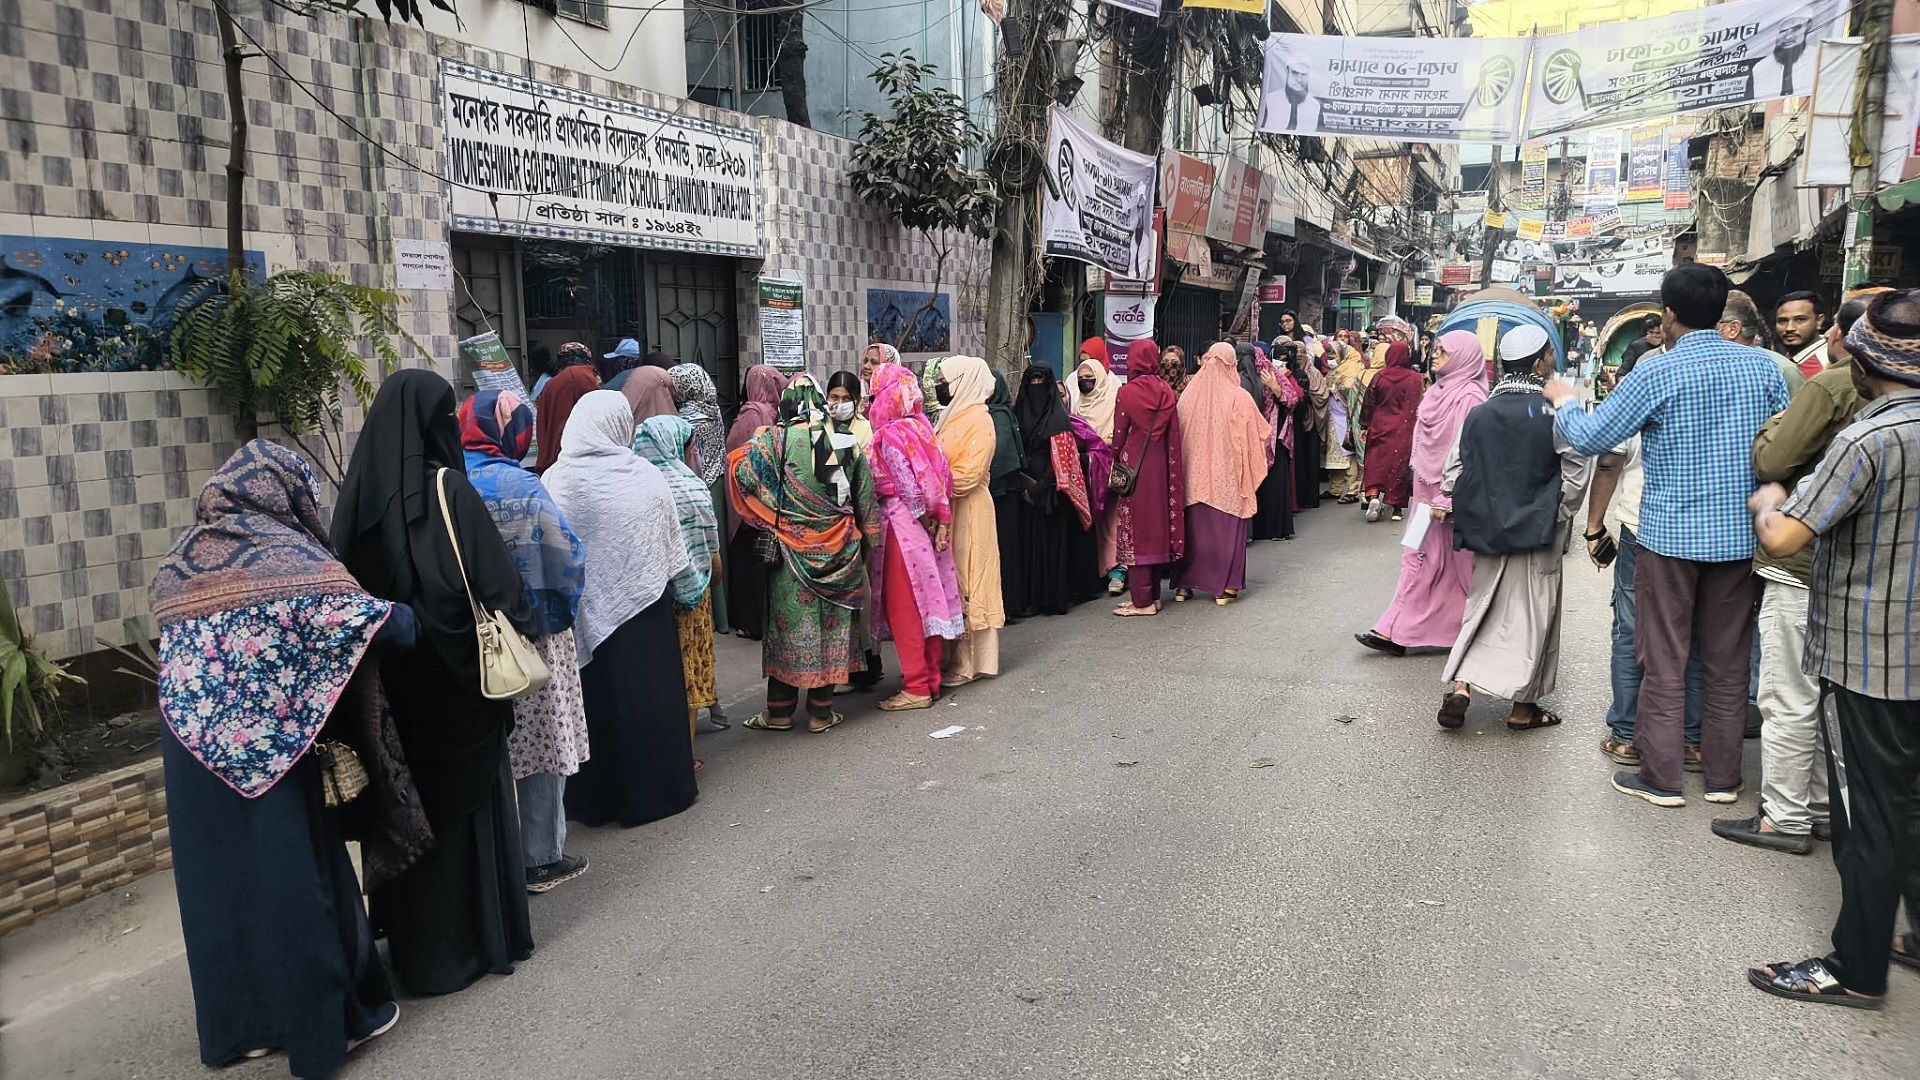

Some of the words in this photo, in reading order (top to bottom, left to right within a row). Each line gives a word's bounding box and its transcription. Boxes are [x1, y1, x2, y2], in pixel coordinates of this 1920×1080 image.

[1698, 22, 1760, 47] আসনে
[449, 92, 500, 135] মনেশ্বর
[503, 99, 552, 141] সরকারি
[556, 108, 601, 149] প্রাথমিক
[604, 114, 652, 168] বিদ্যালয়,
[451, 137, 523, 192] MONESHWAR
[523, 148, 589, 200] GOVERNMENT
[589, 160, 628, 205] PRIMARY
[536, 202, 589, 224] প্রতিষ্ঠা
[596, 212, 626, 228] সাল
[645, 218, 703, 238] ১৯৬৪ইং
[1112, 310, 1146, 324] রকেট
